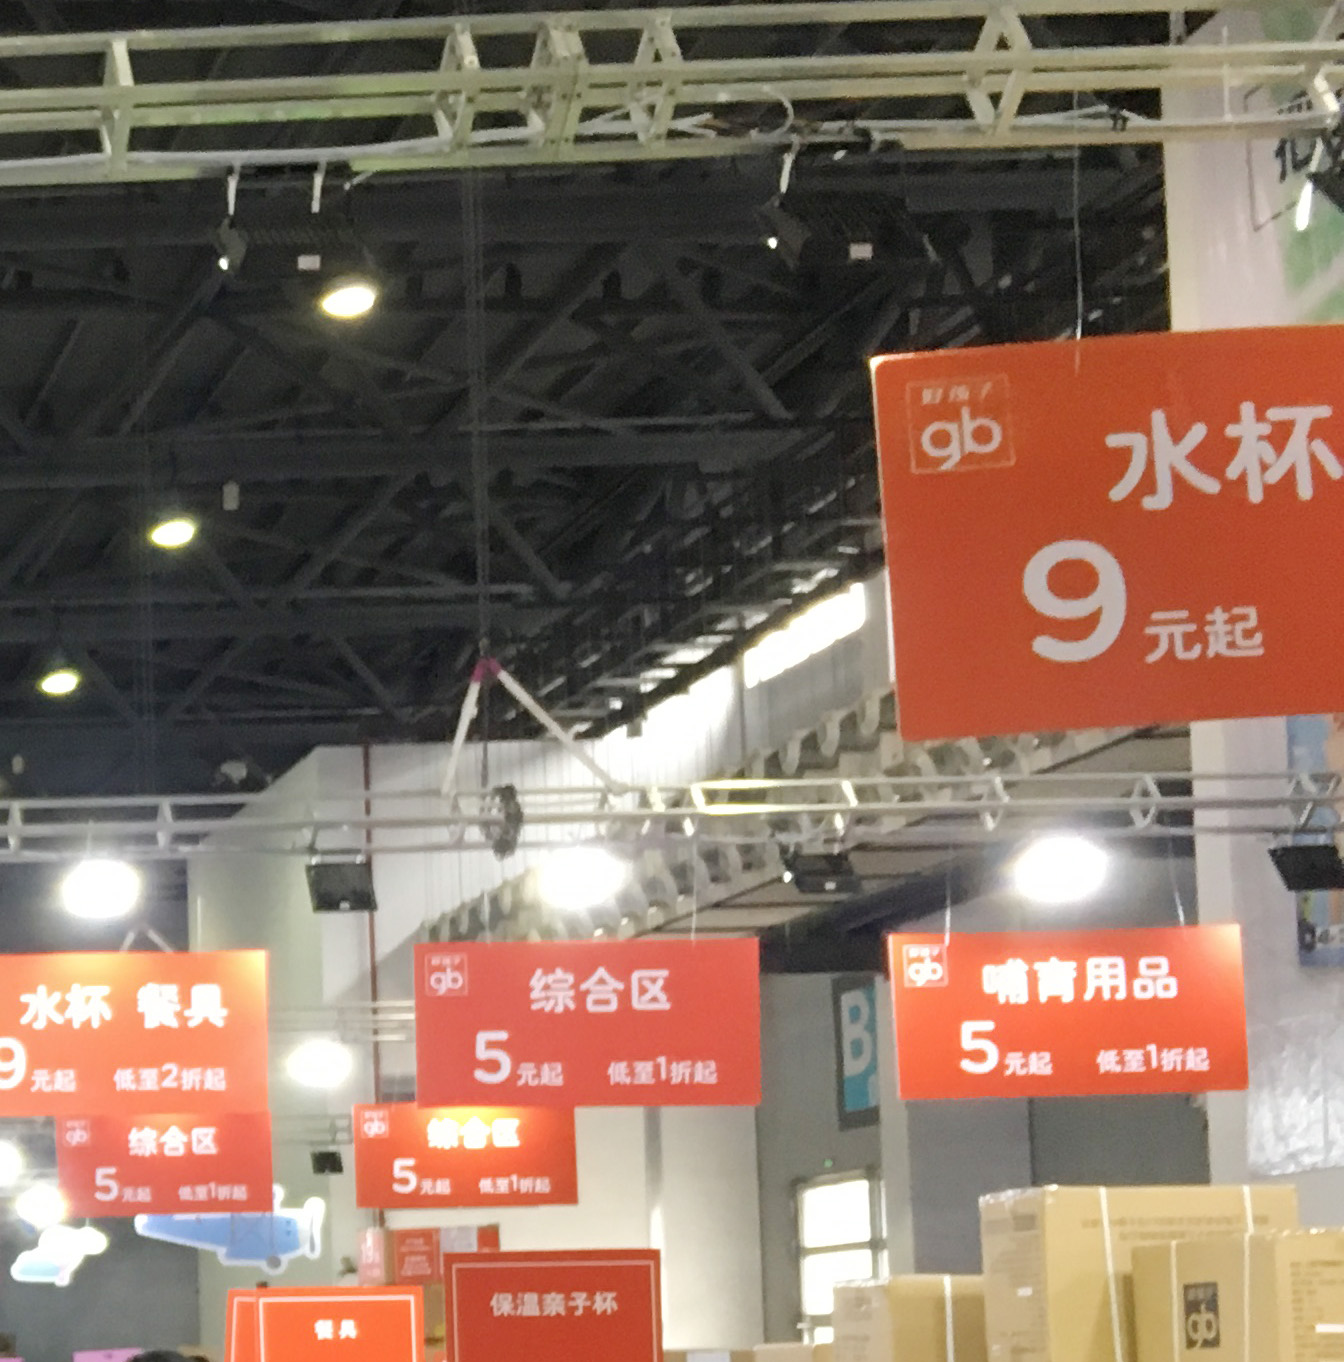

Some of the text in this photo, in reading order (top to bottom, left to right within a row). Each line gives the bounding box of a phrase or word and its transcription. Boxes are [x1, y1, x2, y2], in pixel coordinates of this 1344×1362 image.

[921, 406, 1003, 471] gb
[1105, 400, 1344, 511] 水杯
[1022, 539, 1265, 664] 9元起
[429, 967, 464, 996] gb
[528, 966, 672, 1014] 综合区
[981, 956, 1179, 1006] 哺育用品
[19, 983, 229, 1030] 水杯 餐具
[473, 1030, 718, 1086] 5元起 低至1折起
[959, 1020, 1211, 1077] 5元起 低至1折起
[113, 1063, 227, 1092] 低至2折起
[127, 1126, 218, 1157] 综合区
[93, 1167, 248, 1203] 5元起 低至1折起
[392, 1158, 551, 1196] 5元起 低至1折起
[490, 1291, 619, 1318] 保温亲子杯
